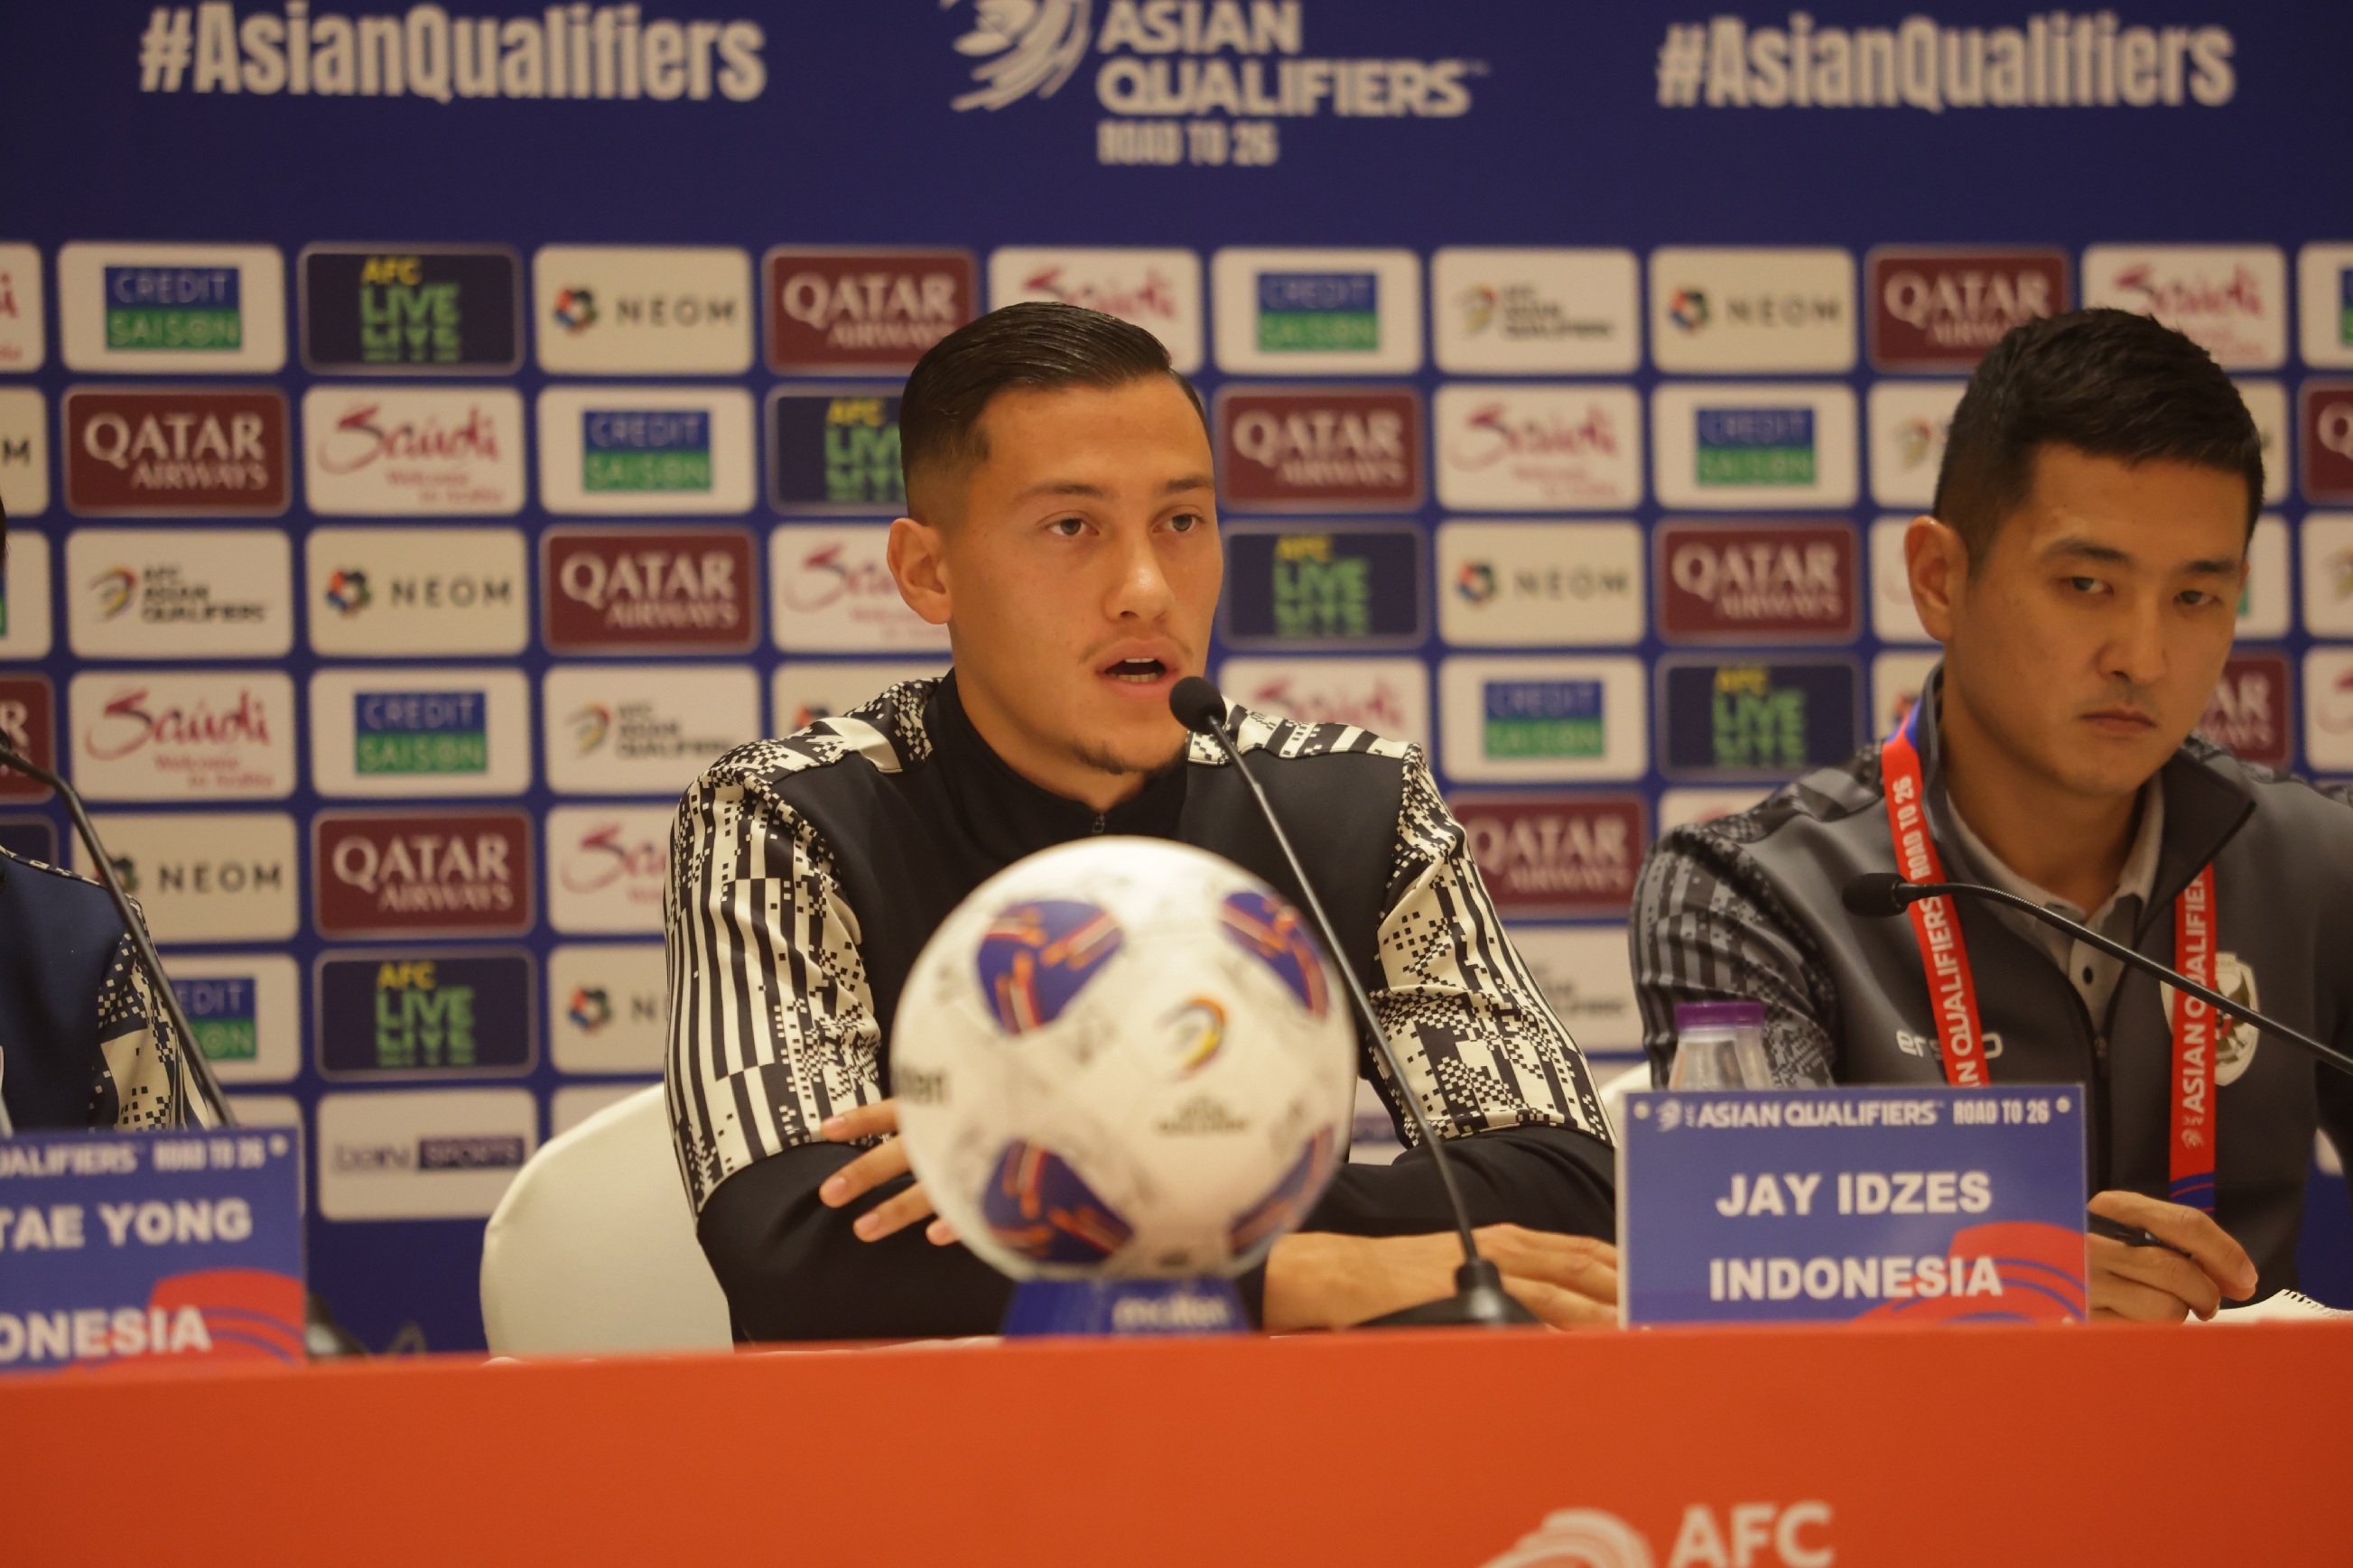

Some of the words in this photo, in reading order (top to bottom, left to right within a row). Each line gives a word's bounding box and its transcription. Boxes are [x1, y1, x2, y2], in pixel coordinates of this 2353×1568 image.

[1097, 0, 1303, 52] ASIAN
[139, 2, 767, 103] #AsianQualifiers
[1656, 12, 2236, 113] #AsianQualifiers
[1095, 59, 1473, 117] QUALIFIERS
[113, 271, 230, 303] CREDIT
[363, 256, 421, 283] AFC
[363, 284, 461, 325] LIVE
[615, 297, 737, 327] NEOM
[783, 272, 957, 330] QATAR
[1726, 297, 1840, 327] NEOM
[1884, 272, 2051, 330] QATAR
[826, 400, 886, 426] AFC
[85, 413, 265, 469] QATAR
[1232, 409, 1403, 468] QATAR
[132, 463, 269, 491] AIRWAYS
[389, 575, 511, 608] NEOM
[561, 552, 736, 610] QATAR
[1671, 543, 1841, 602] QATAR
[85, 686, 270, 762] Saudi
[364, 700, 474, 731] CREDIT
[362, 738, 484, 769] SAISON
[1893, 775, 1912, 801] 26
[1899, 803, 1918, 830] TO
[332, 835, 511, 893] QATAR
[1466, 815, 1631, 875] QATAR
[1900, 830, 1931, 879] ROAD
[158, 864, 282, 894] NEOM
[378, 883, 514, 912] AIRWAYS
[378, 962, 436, 989] AFC
[1918, 895, 1974, 1056] QUALIFIERS
[377, 990, 475, 1029] LIVE
[2181, 1024, 2206, 1115] ASIAN
[1697, 1101, 1781, 1128] ASIAN
[1784, 1099, 1939, 1127] QUALIFIERS
[1953, 1099, 1998, 1125] ROAD
[2002, 1099, 2023, 1125] TO
[2026, 1099, 2051, 1125] 26
[1716, 1174, 1821, 1217] JAY
[1837, 1171, 1993, 1214] IDZES
[98, 1196, 253, 1248] YONG
[1709, 1256, 2003, 1302] INDONESIA
[1667, 1499, 1835, 1568] AFC
